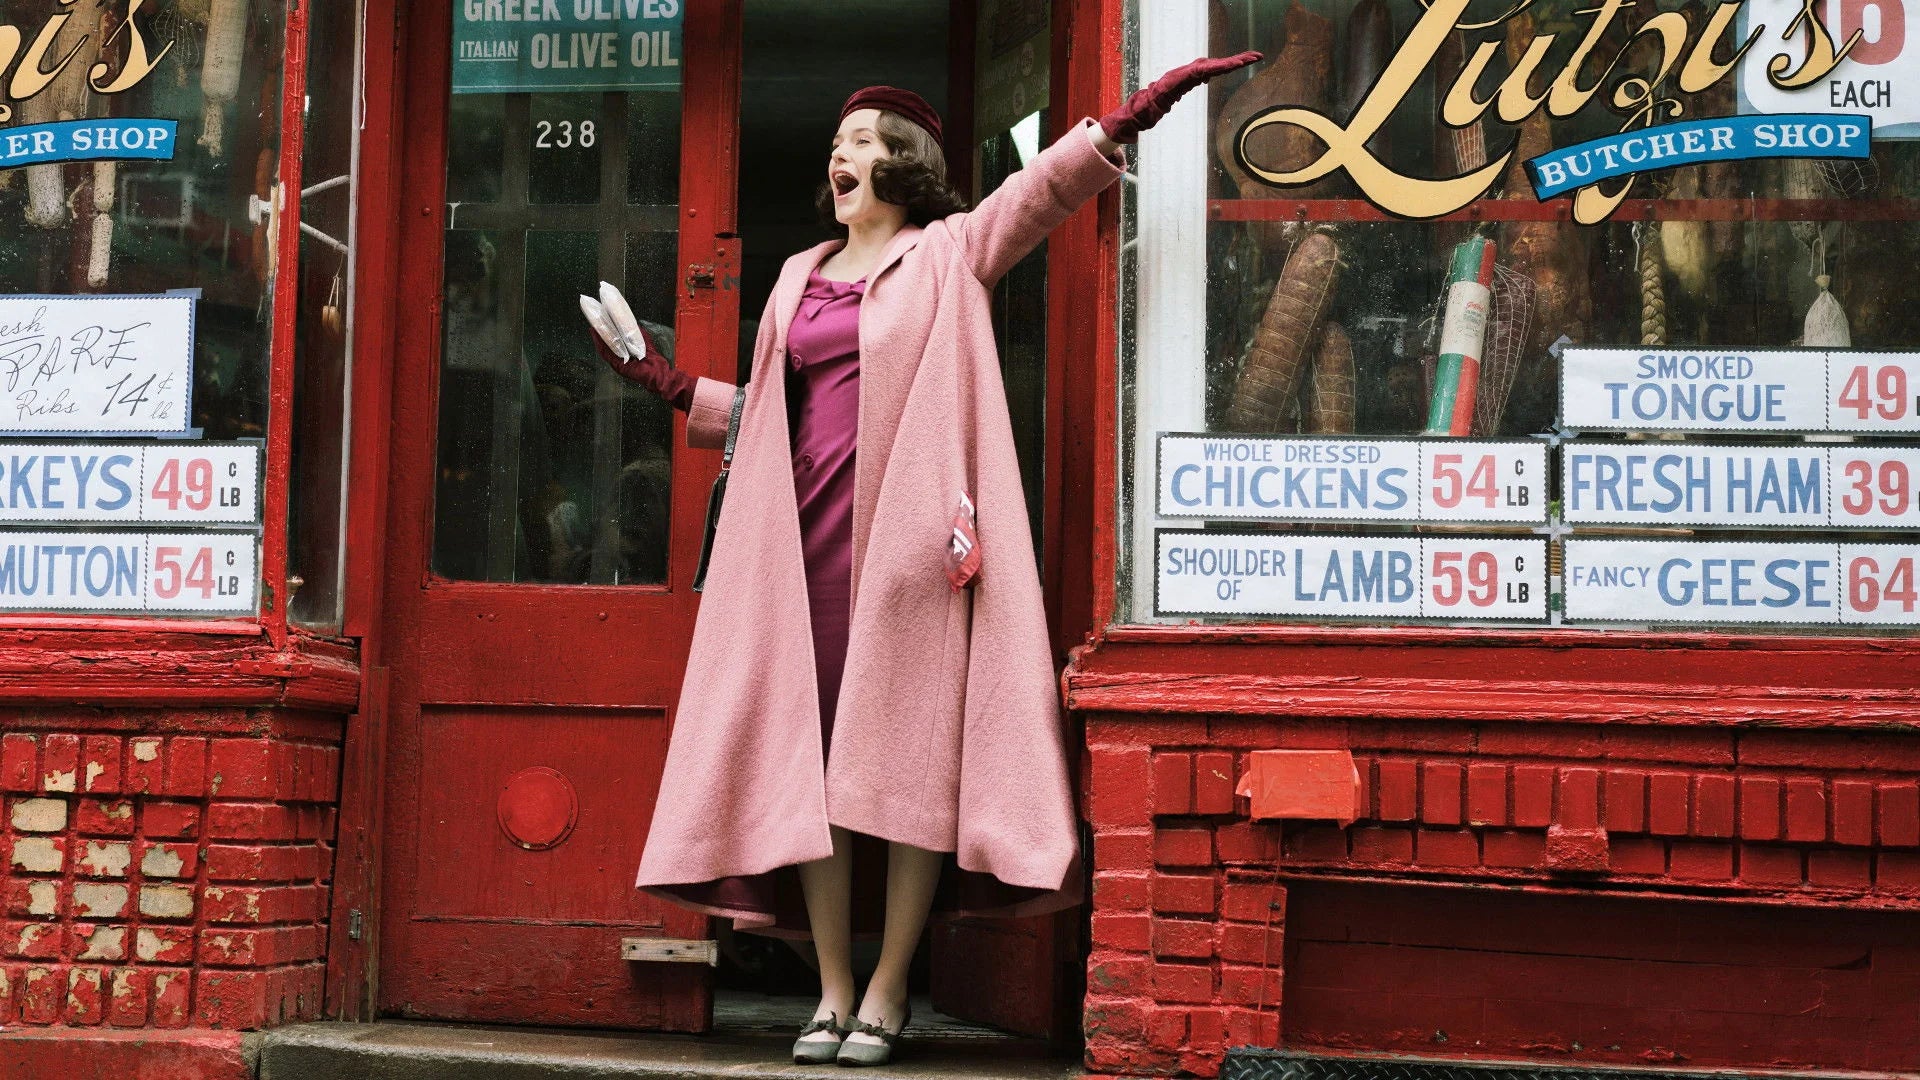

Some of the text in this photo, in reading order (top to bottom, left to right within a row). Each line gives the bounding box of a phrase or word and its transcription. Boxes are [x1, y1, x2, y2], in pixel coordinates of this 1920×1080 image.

[464, 0, 679, 21] GREEK OLIVES
[459, 31, 679, 69] ITALIAN OLIVE OIL
[1830, 80, 1891, 108] EACH
[1233, 0, 1864, 226] Lutzis
[0, 127, 169, 159] ER SHOP
[535, 120, 596, 148] 238
[1537, 123, 1861, 187] BUTCHER SHOP
[1637, 355, 1753, 379] SMOKED
[16, 388, 79, 422] Ribs
[102, 373, 157, 416] 14
[1604, 383, 1786, 422] TONGUE
[1839, 366, 1908, 420] 49
[1203, 443, 1381, 464] WHOLE DRESSED
[151, 458, 213, 511] 49
[220, 487, 240, 507] LB
[1171, 463, 1408, 510] CHICKENS
[1432, 454, 1499, 508] 54
[1507, 486, 1529, 506] LB
[1571, 454, 1910, 516] FRESH HAM 39
[0, 545, 139, 597] MUTTON
[154, 546, 215, 599] 54
[218, 576, 239, 596] LB
[1167, 547, 1286, 577] SHOULDER
[1294, 548, 1414, 604] LAMB
[1432, 551, 1498, 607] 59
[1573, 557, 1918, 613] FANCY GEESE 64
[1216, 579, 1242, 601] OF
[1507, 583, 1529, 603] LB
